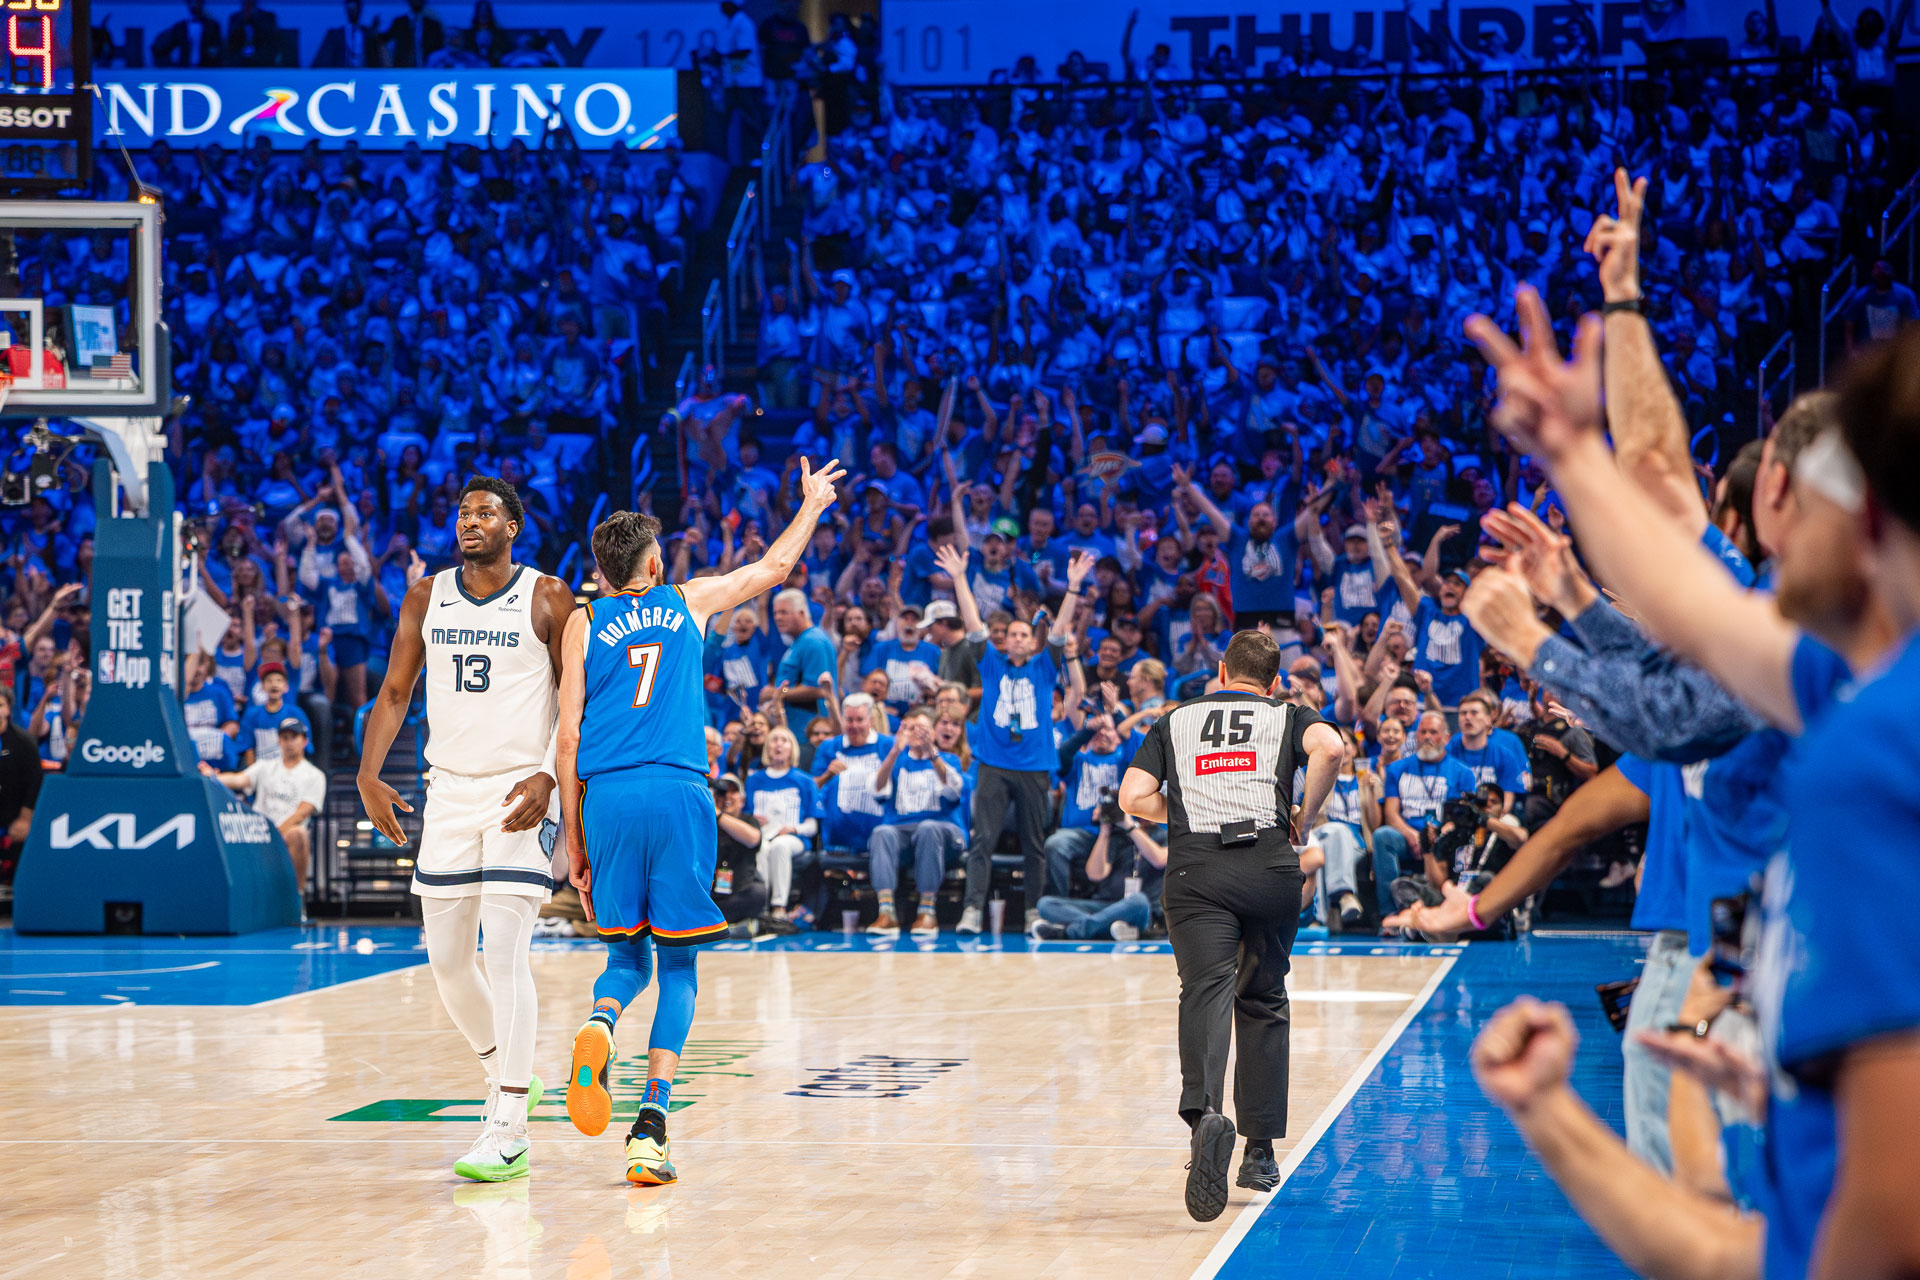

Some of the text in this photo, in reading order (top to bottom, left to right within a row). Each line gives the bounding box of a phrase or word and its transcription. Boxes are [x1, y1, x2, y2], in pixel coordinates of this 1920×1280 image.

[892, 25, 971, 72] 101
[1170, 3, 1647, 76] THUNDER
[0, 106, 71, 128] SSOT
[307, 81, 632, 140] CASINO
[107, 588, 143, 618] GET
[107, 620, 143, 650] THE
[431, 628, 519, 648] MEMPHIS
[597, 607, 685, 648] HOLMGREN
[115, 655, 151, 688] App
[452, 654, 491, 692] 13
[627, 642, 662, 708] 7
[1200, 709, 1254, 748] 45
[82, 738, 165, 768] Google
[1201, 756, 1251, 770] Emirates
[50, 812, 195, 850] KIA
